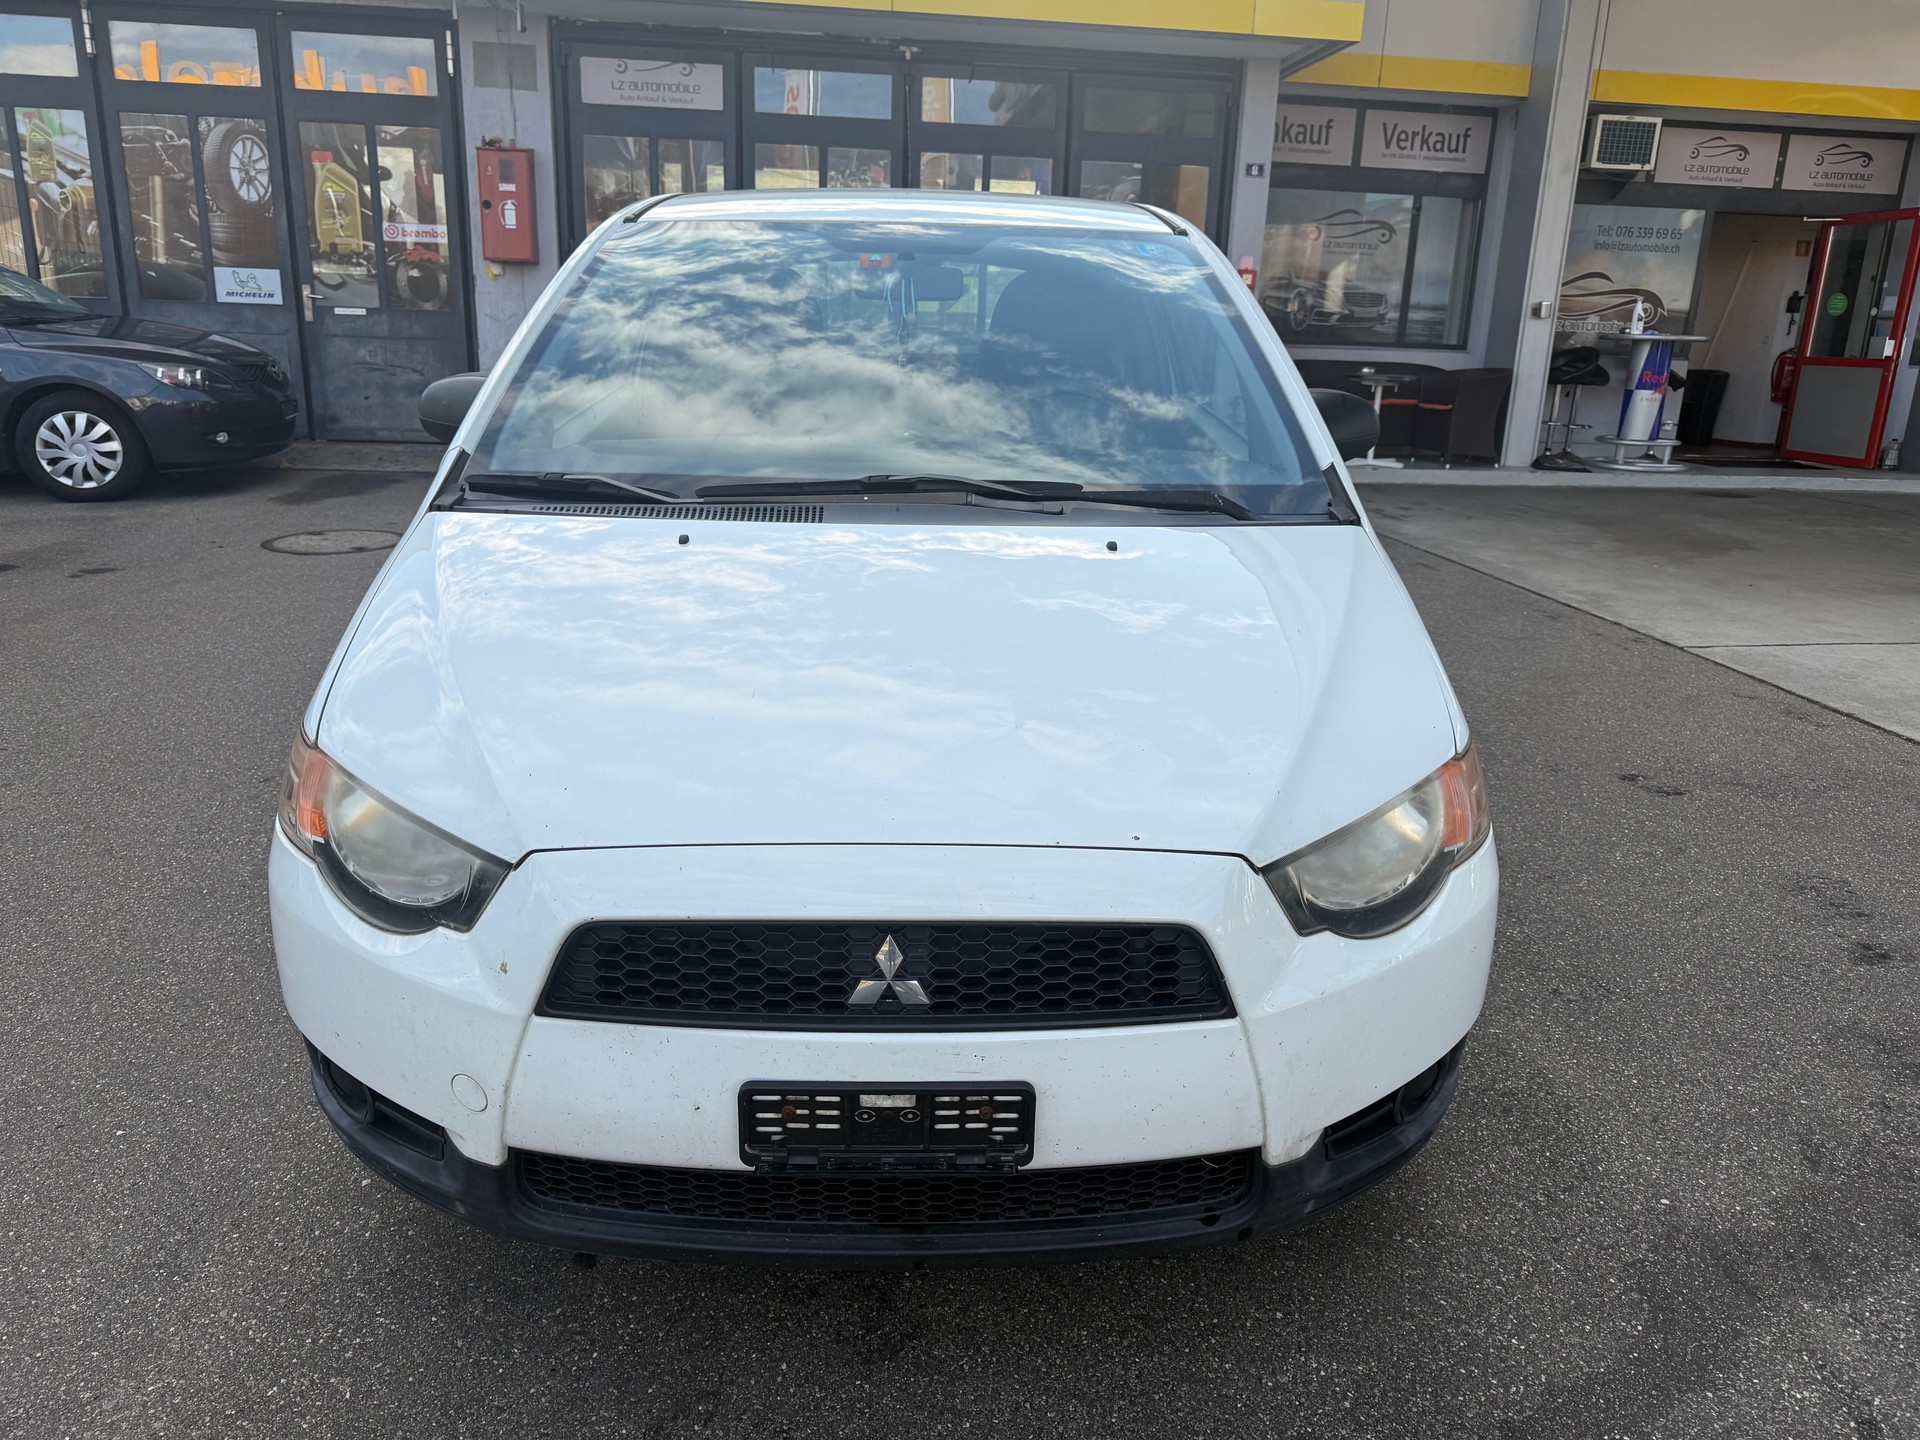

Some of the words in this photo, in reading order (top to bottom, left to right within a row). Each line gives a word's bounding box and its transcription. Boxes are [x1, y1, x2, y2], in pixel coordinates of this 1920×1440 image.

[611, 80, 625, 91] LZ
[619, 94, 635, 102] Auto
[1382, 121, 1472, 154] Verkauf
[1684, 163, 1696, 173] LZ
[1809, 171, 1820, 180] LZ
[401, 227, 447, 239] brembo
[1597, 224, 1614, 238] Tel:
[1615, 225, 1634, 239] 076
[1635, 226, 1654, 239] 339
[1656, 227, 1669, 240] 69
[1670, 228, 1683, 240] 65
[225, 290, 275, 299] MICHELIN
